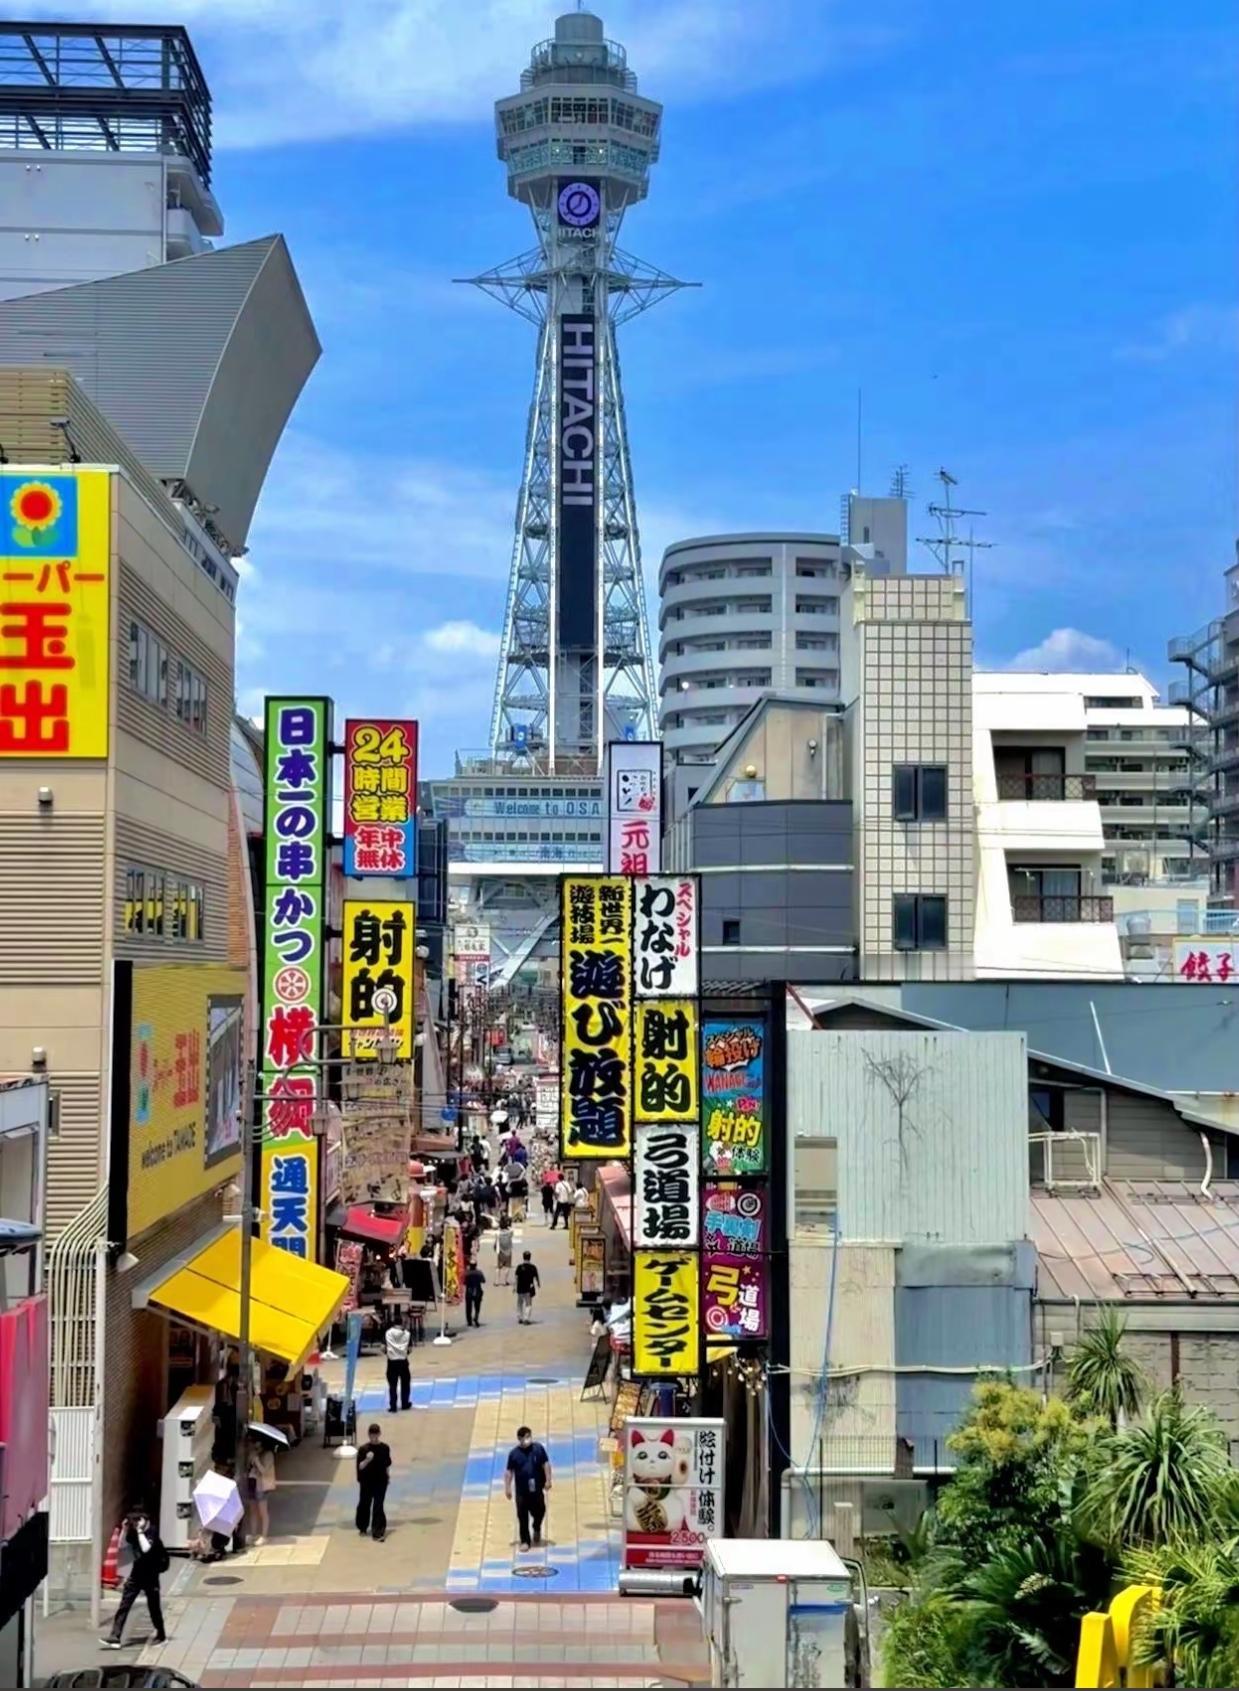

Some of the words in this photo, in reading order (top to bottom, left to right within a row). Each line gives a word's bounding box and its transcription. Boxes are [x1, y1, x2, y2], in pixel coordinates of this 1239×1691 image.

[563, 323, 594, 506] HITACHI
[0, 603, 75, 751] 玉出
[352, 766, 408, 792] 時間
[353, 726, 409, 764] 24
[274, 708, 316, 963] 日本一の串かつ
[351, 795, 408, 822] 営業
[356, 828, 404, 847] 年中
[494, 802, 540, 815] Welcome
[545, 801, 559, 815] to
[355, 849, 404, 870] 無休
[621, 821, 650, 878] 元祖
[570, 885, 595, 944] 遊技場
[640, 884, 678, 990] わなげ
[675, 883, 692, 958] スペシャル
[350, 910, 406, 1023] 射的
[268, 1004, 317, 1139] 横綱
[568, 950, 626, 1147] 遊び放題
[640, 1009, 691, 1113] 射的
[707, 1109, 762, 1147] 射的
[643, 1133, 691, 1240] 弓道場
[642, 1257, 691, 1368] ゲームセンター
[707, 1264, 740, 1306] 弓
[738, 1283, 761, 1332] 道場
